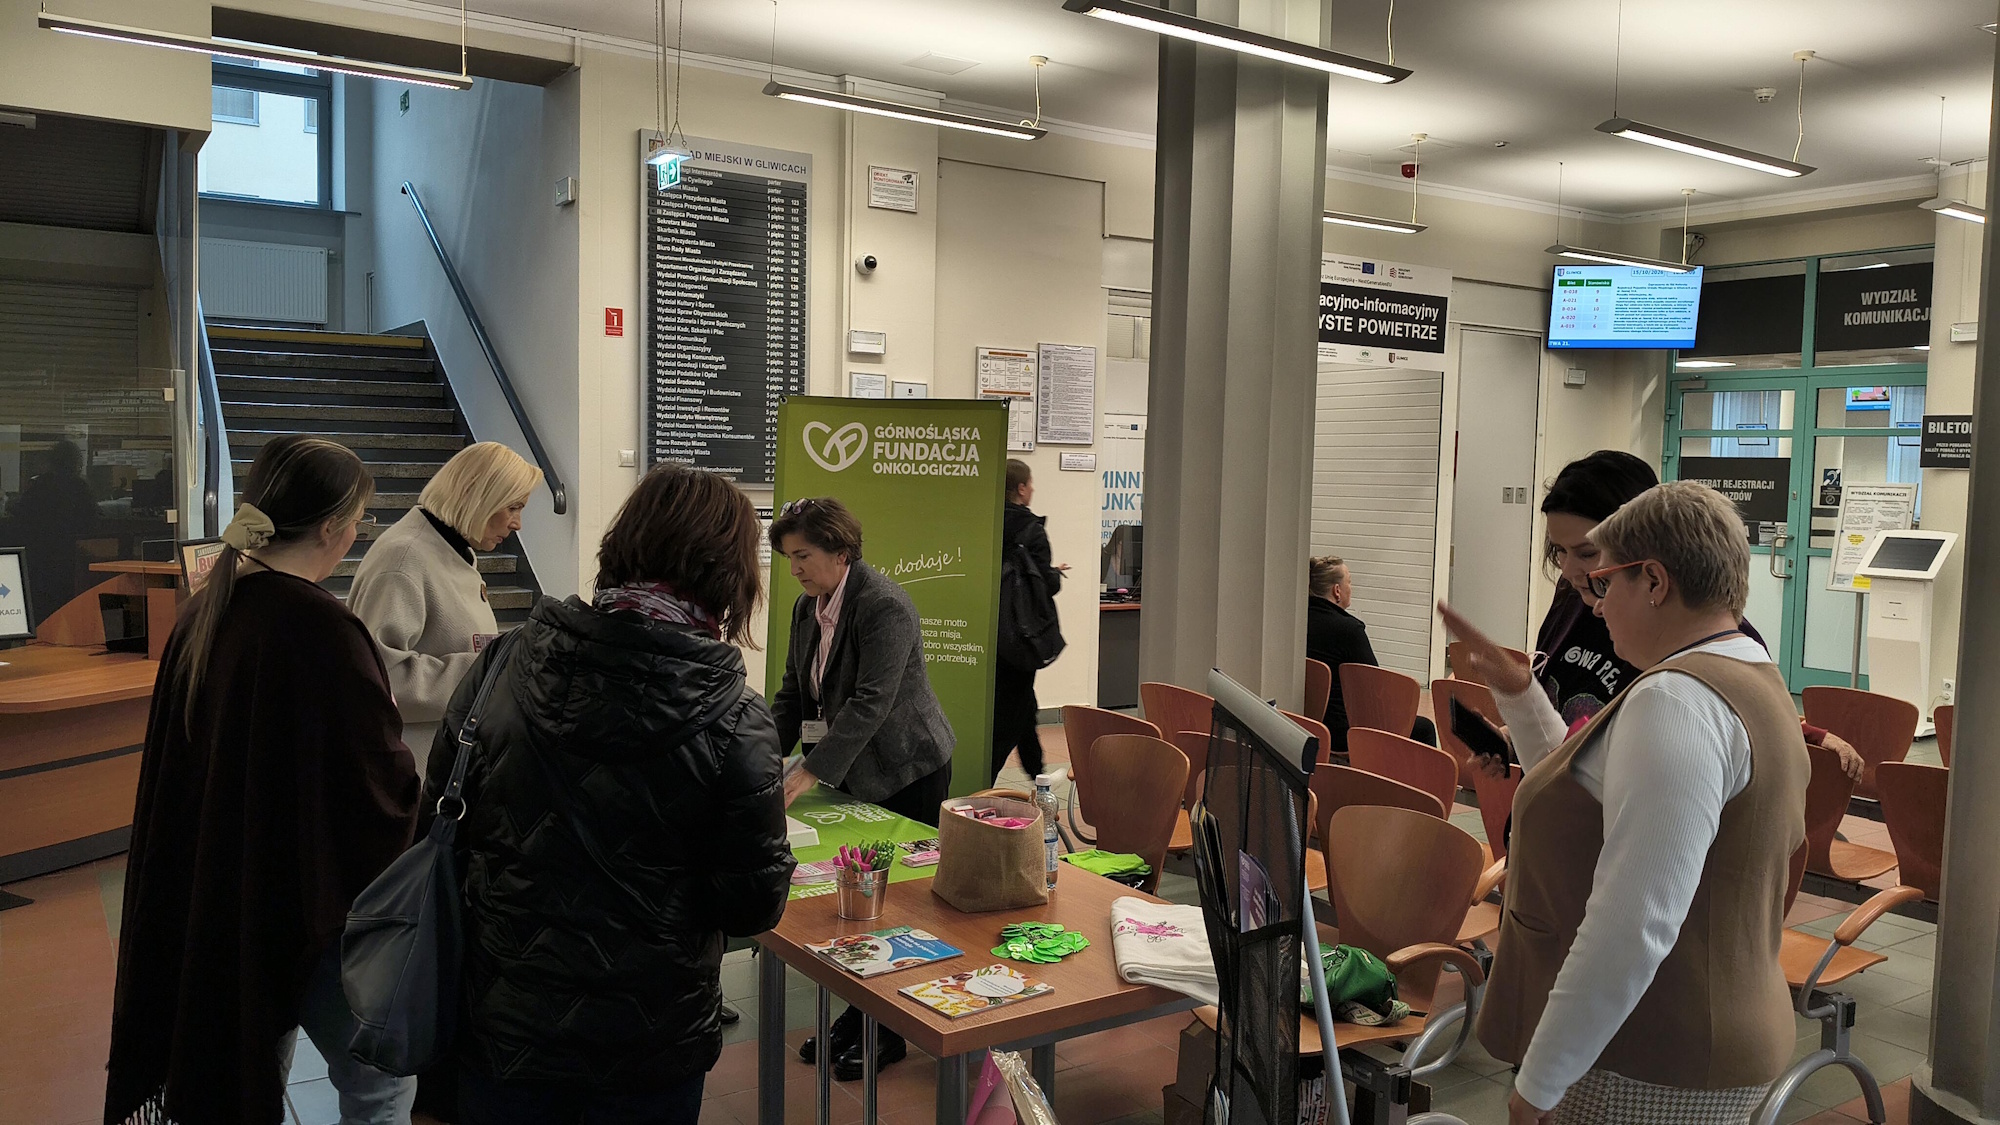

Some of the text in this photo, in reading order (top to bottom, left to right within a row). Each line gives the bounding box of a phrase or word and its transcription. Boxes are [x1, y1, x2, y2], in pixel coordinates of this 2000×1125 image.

[705, 152, 742, 166] MIEJSKI
[743, 158, 753, 167] W
[756, 161, 807, 174] GLIWICACH
[688, 178, 714, 186] Cywilnego
[874, 176, 906, 185] MONITOROWANY
[683, 194, 710, 202] Prezydenta
[661, 200, 683, 208] Zastępca
[684, 203, 711, 211] Prezydenta
[663, 209, 685, 217] Zastępca
[686, 212, 712, 221] Prezydenta
[672, 237, 699, 245] Prezydenta
[657, 262, 747, 277] Departament Organizacji Zarządzania
[657, 271, 758, 287] Wydział Promocji Komunikacji Społecznej
[1358, 279, 1392, 289] NextGenerationEU
[657, 280, 708, 290] Wydział Księgowości
[677, 290, 704, 299] Informatyki
[1860, 289, 1918, 305] WYDZIAŁ
[677, 307, 693, 316] Spraw
[693, 309, 728, 319] Obywatelskich
[1319, 294, 1438, 321] acyjno-informacyjny
[657, 315, 676, 323] Wydział
[677, 325, 690, 333] Kadr,
[1318, 314, 1437, 340] YSTE POWIETRZE
[677, 334, 707, 344] Komunikacji
[677, 343, 711, 353] Organizacyjny
[692, 353, 725, 362] Komunalnych
[657, 360, 676, 368] Wydział
[657, 369, 676, 377] Wydział
[657, 386, 676, 395] Wydział
[677, 396, 703, 404] Finansowy
[874, 422, 980, 443] GÓRNOŚLĄSKA
[872, 442, 980, 462] FUNDACJA
[872, 462, 979, 477] ONKOLOGICZNA
[1102, 470, 1144, 488] INN
[1692, 479, 1774, 490] EFERAT REJESTRACJI
[894, 552, 954, 578] dodaje
[919, 618, 967, 628] nasze motto
[920, 628, 962, 640] asza misja.
[923, 640, 984, 655] obro wszystkim,
[924, 652, 978, 666] go potrzebują.
